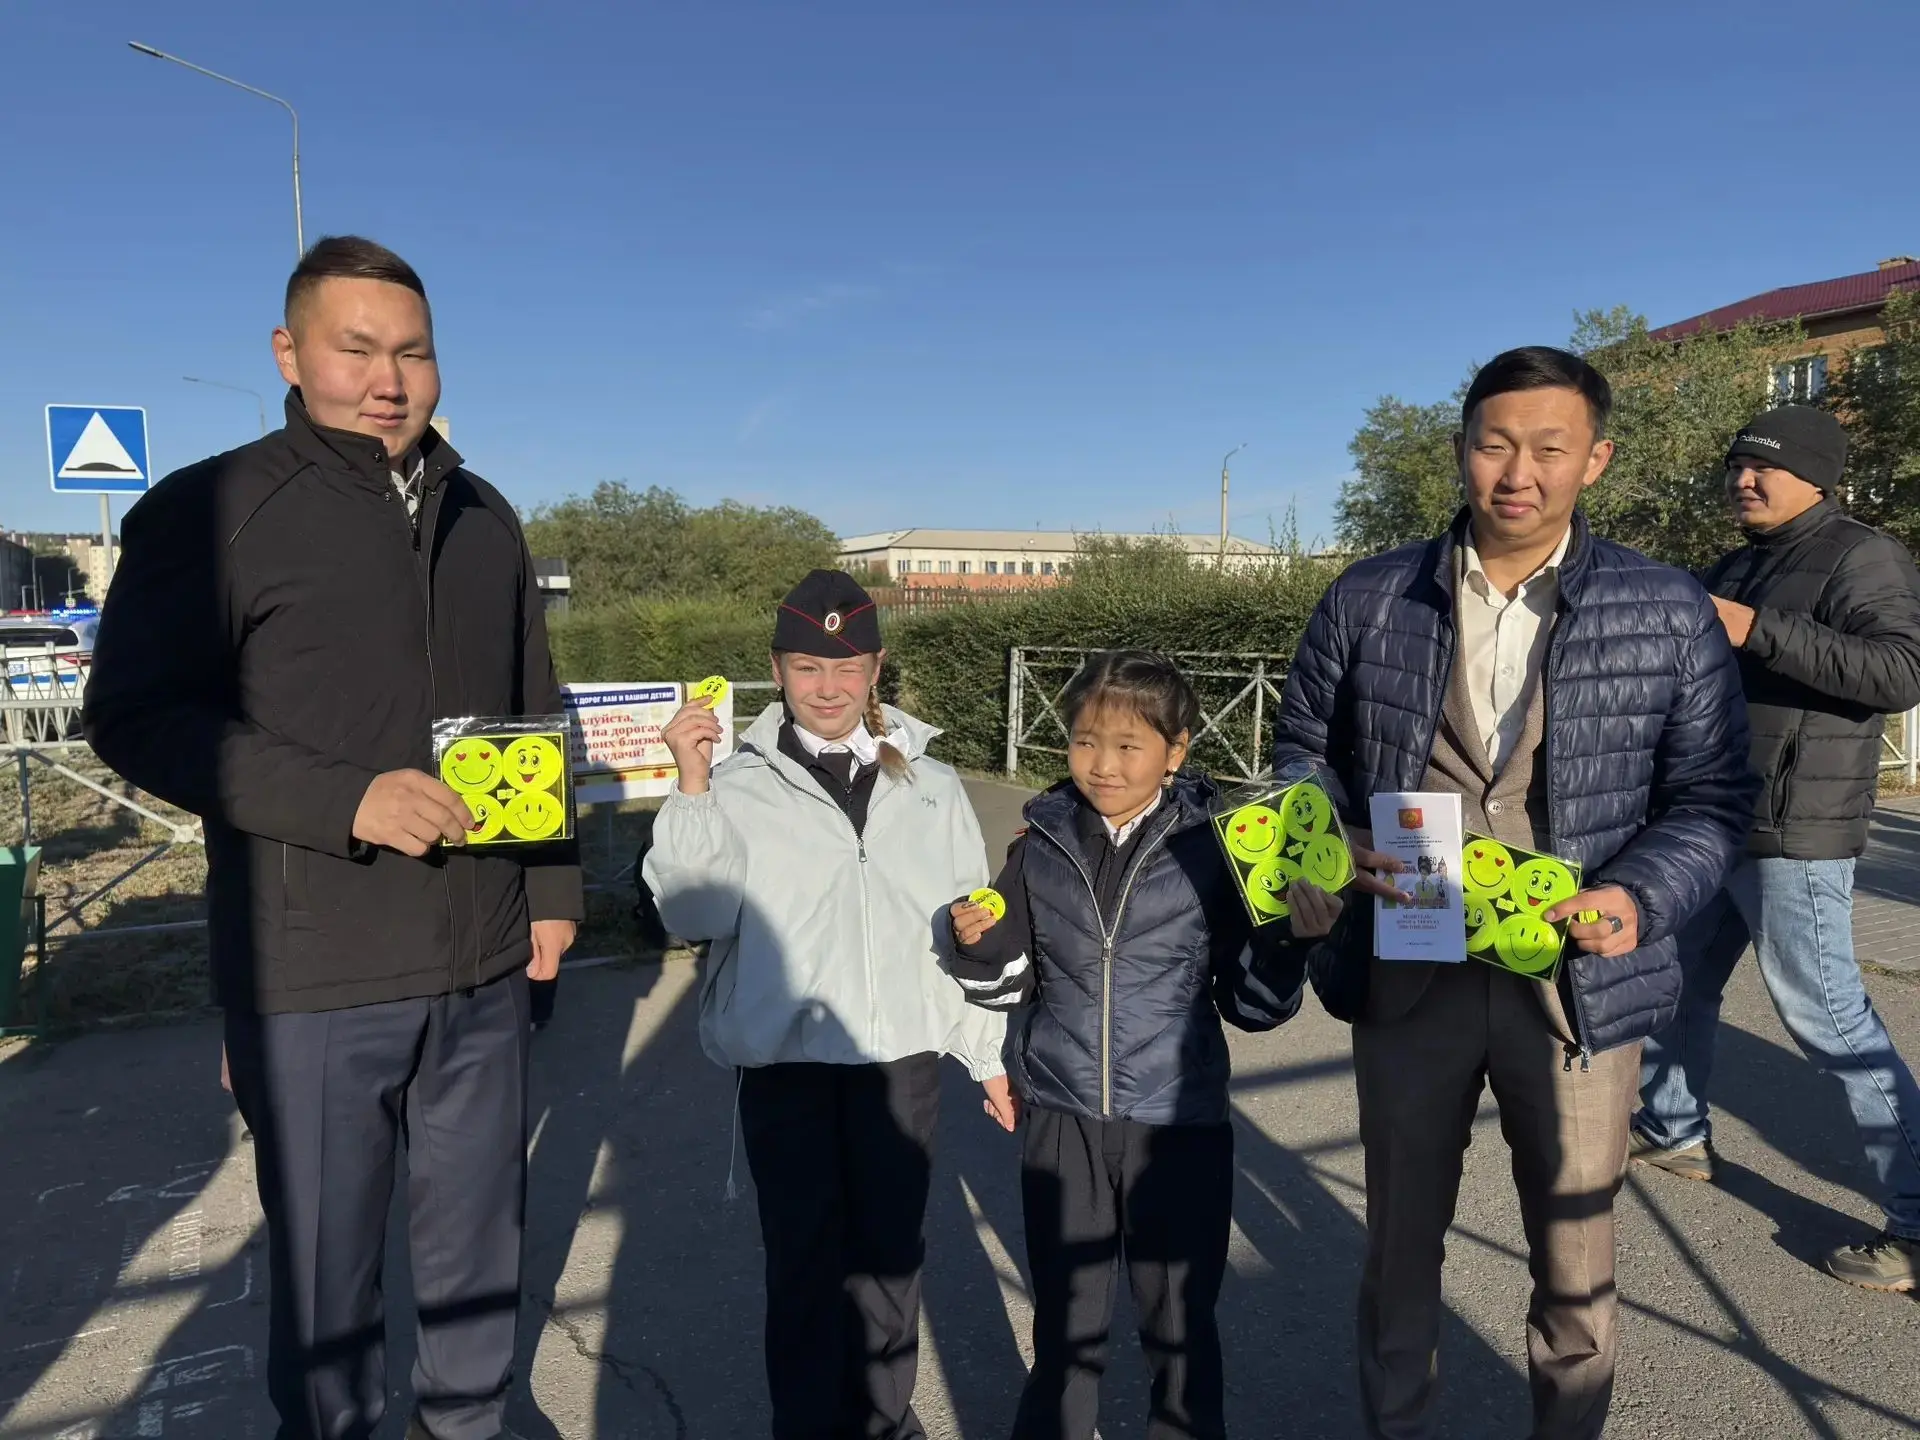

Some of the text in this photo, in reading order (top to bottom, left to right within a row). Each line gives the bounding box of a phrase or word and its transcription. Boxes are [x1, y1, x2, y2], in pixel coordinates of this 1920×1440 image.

[1739, 434, 1781, 449] Columbia
[579, 696, 601, 705] ДОРОГ
[625, 693, 649, 701] ВАШИМ
[650, 691, 674, 700] ДЕТЯМ!
[592, 729, 608, 737] на
[611, 724, 662, 737] дорогах
[578, 741, 617, 751] своих
[618, 735, 666, 747] близки
[591, 753, 598, 761] и
[603, 748, 645, 763] удачи!
